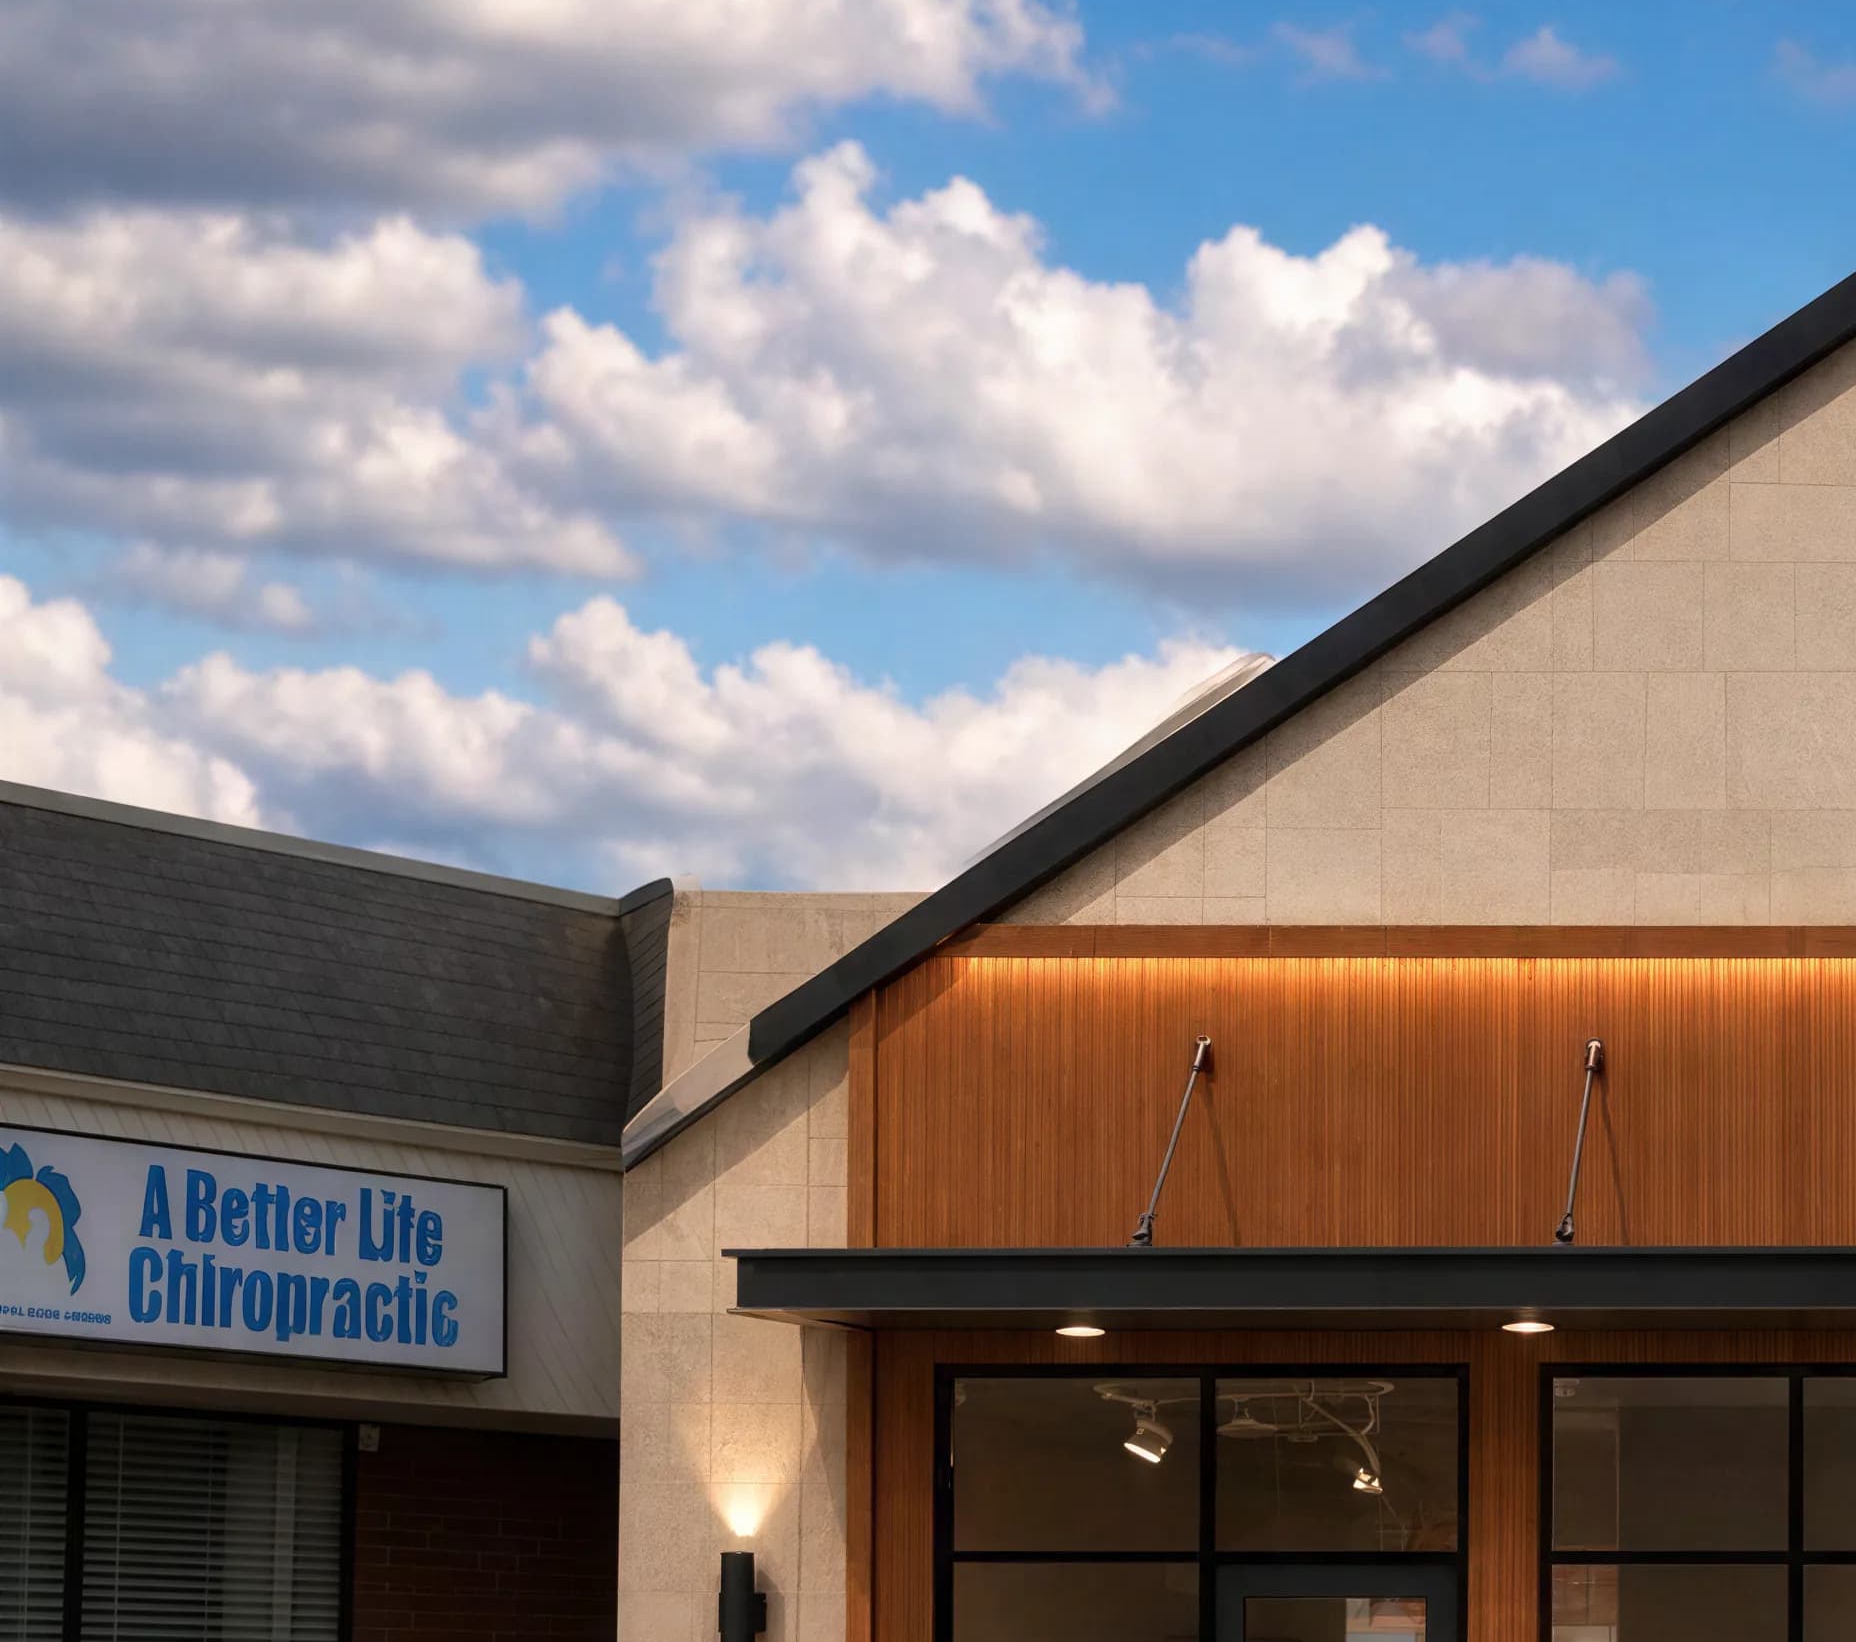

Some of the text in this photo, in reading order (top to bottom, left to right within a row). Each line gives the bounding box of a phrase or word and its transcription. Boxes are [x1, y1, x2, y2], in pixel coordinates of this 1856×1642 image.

[138, 1163, 174, 1241] A
[184, 1168, 347, 1256] Better
[127, 1246, 460, 1348] Chiropractic
